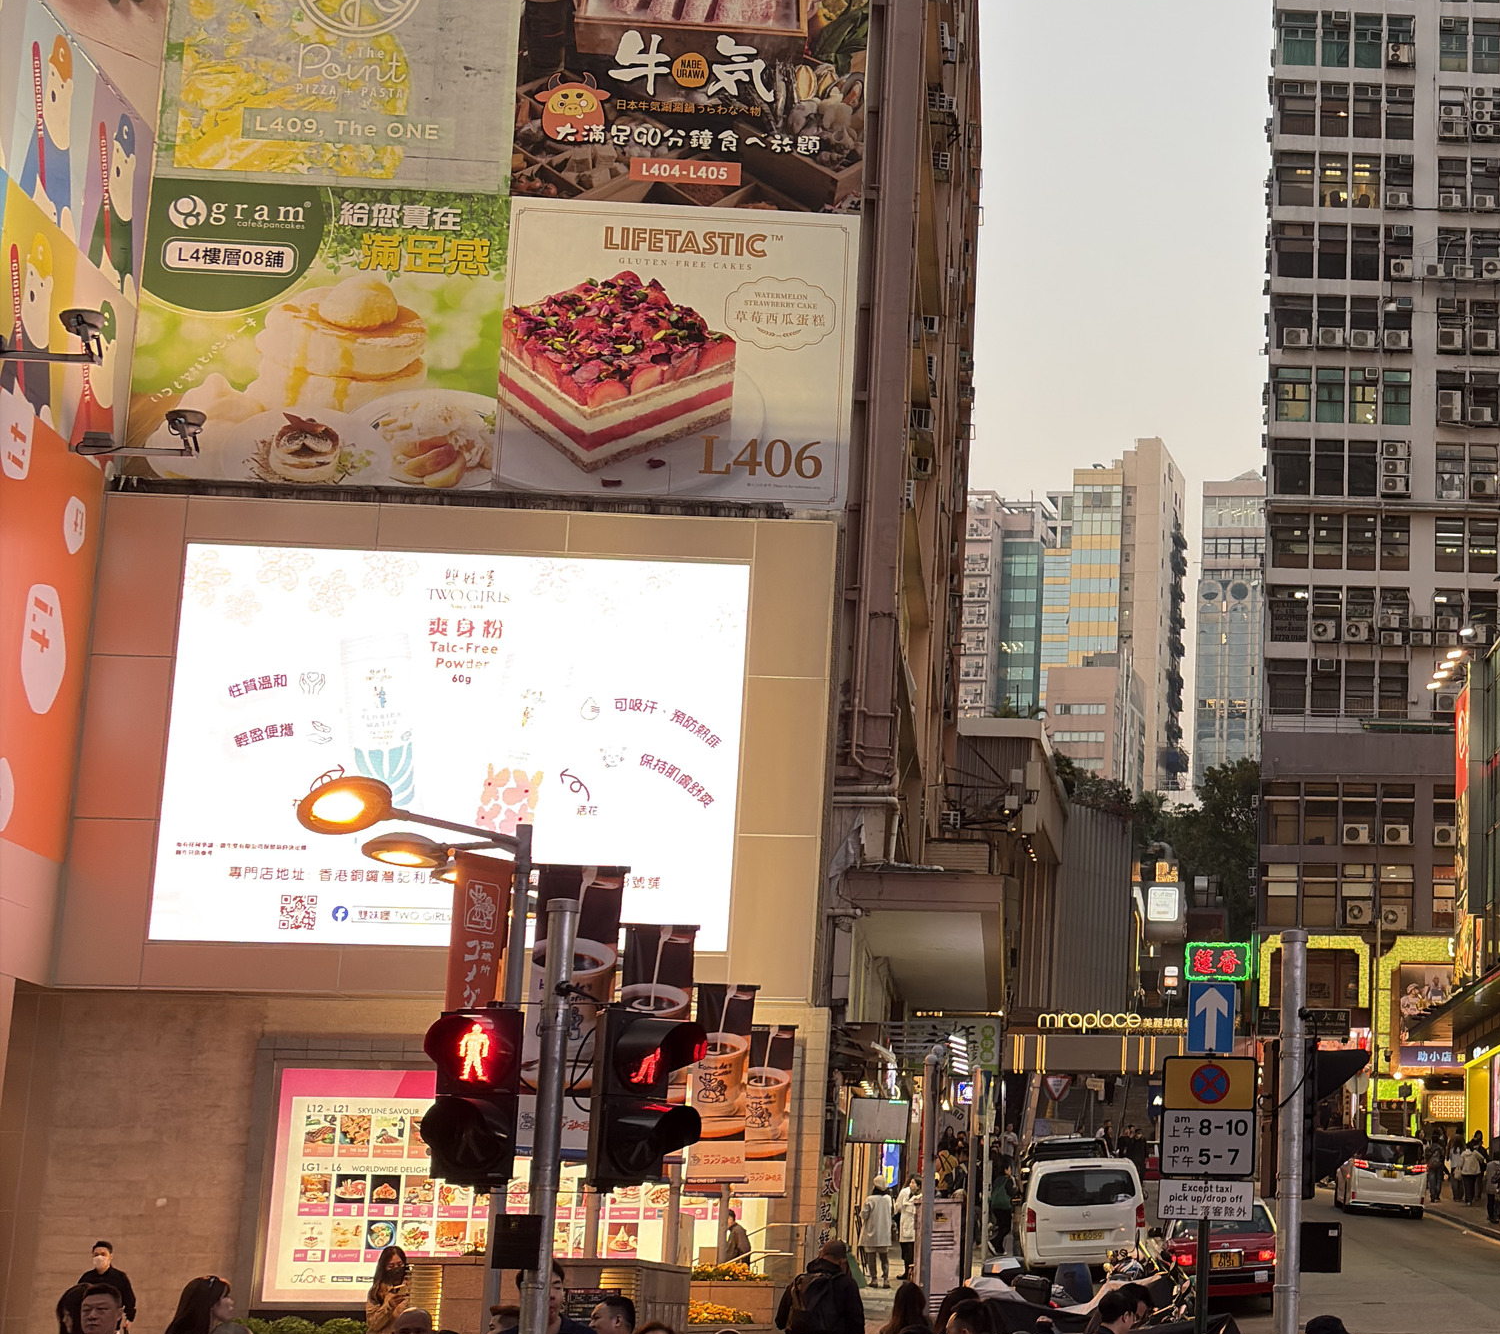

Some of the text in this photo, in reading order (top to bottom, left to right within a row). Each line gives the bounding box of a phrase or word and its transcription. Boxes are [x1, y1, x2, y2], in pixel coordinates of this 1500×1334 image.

[357, 46, 386, 60] The
[297, 42, 407, 84] Point
[296, 83, 406, 99] PIZZA PASTA
[255, 115, 440, 140] L409, The ONE
[641, 163, 729, 182] L404-L405
[210, 202, 306, 226] gram
[339, 201, 463, 232] 給您實在
[603, 225, 768, 259] LIFETASTIC
[360, 233, 492, 277] 滿足感
[713, 262, 754, 273] CAKES
[754, 292, 809, 302] WATERMELON
[743, 299, 819, 311] STRAWBERRY CAKE
[734, 310, 827, 329] 草莓西瓜蛋糕
[698, 434, 824, 481] L406
[428, 617, 503, 640] 爽身粉
[430, 641, 499, 655] Talc-Free
[436, 657, 490, 670] Powder
[228, 673, 288, 699] 性質溫和
[451, 673, 472, 685] 60g
[1037, 1009, 1142, 1034] miraplace
[307, 1105, 323, 1114] L12
[333, 1105, 349, 1113] L21
[357, 1107, 388, 1115] SKYLINE
[1174, 1115, 1191, 1123] am
[1168, 1118, 1248, 1138] 上午 8-10
[1173, 1145, 1190, 1154] pm
[1168, 1154, 1195, 1168] 下午
[302, 1163, 398, 1174] LG1 L6 WORLDWIDE
[1181, 1183, 1233, 1195] Except taxi
[1169, 1192, 1243, 1205] pick up/drop off
[1163, 1204, 1247, 1217] 的士上落客除外
